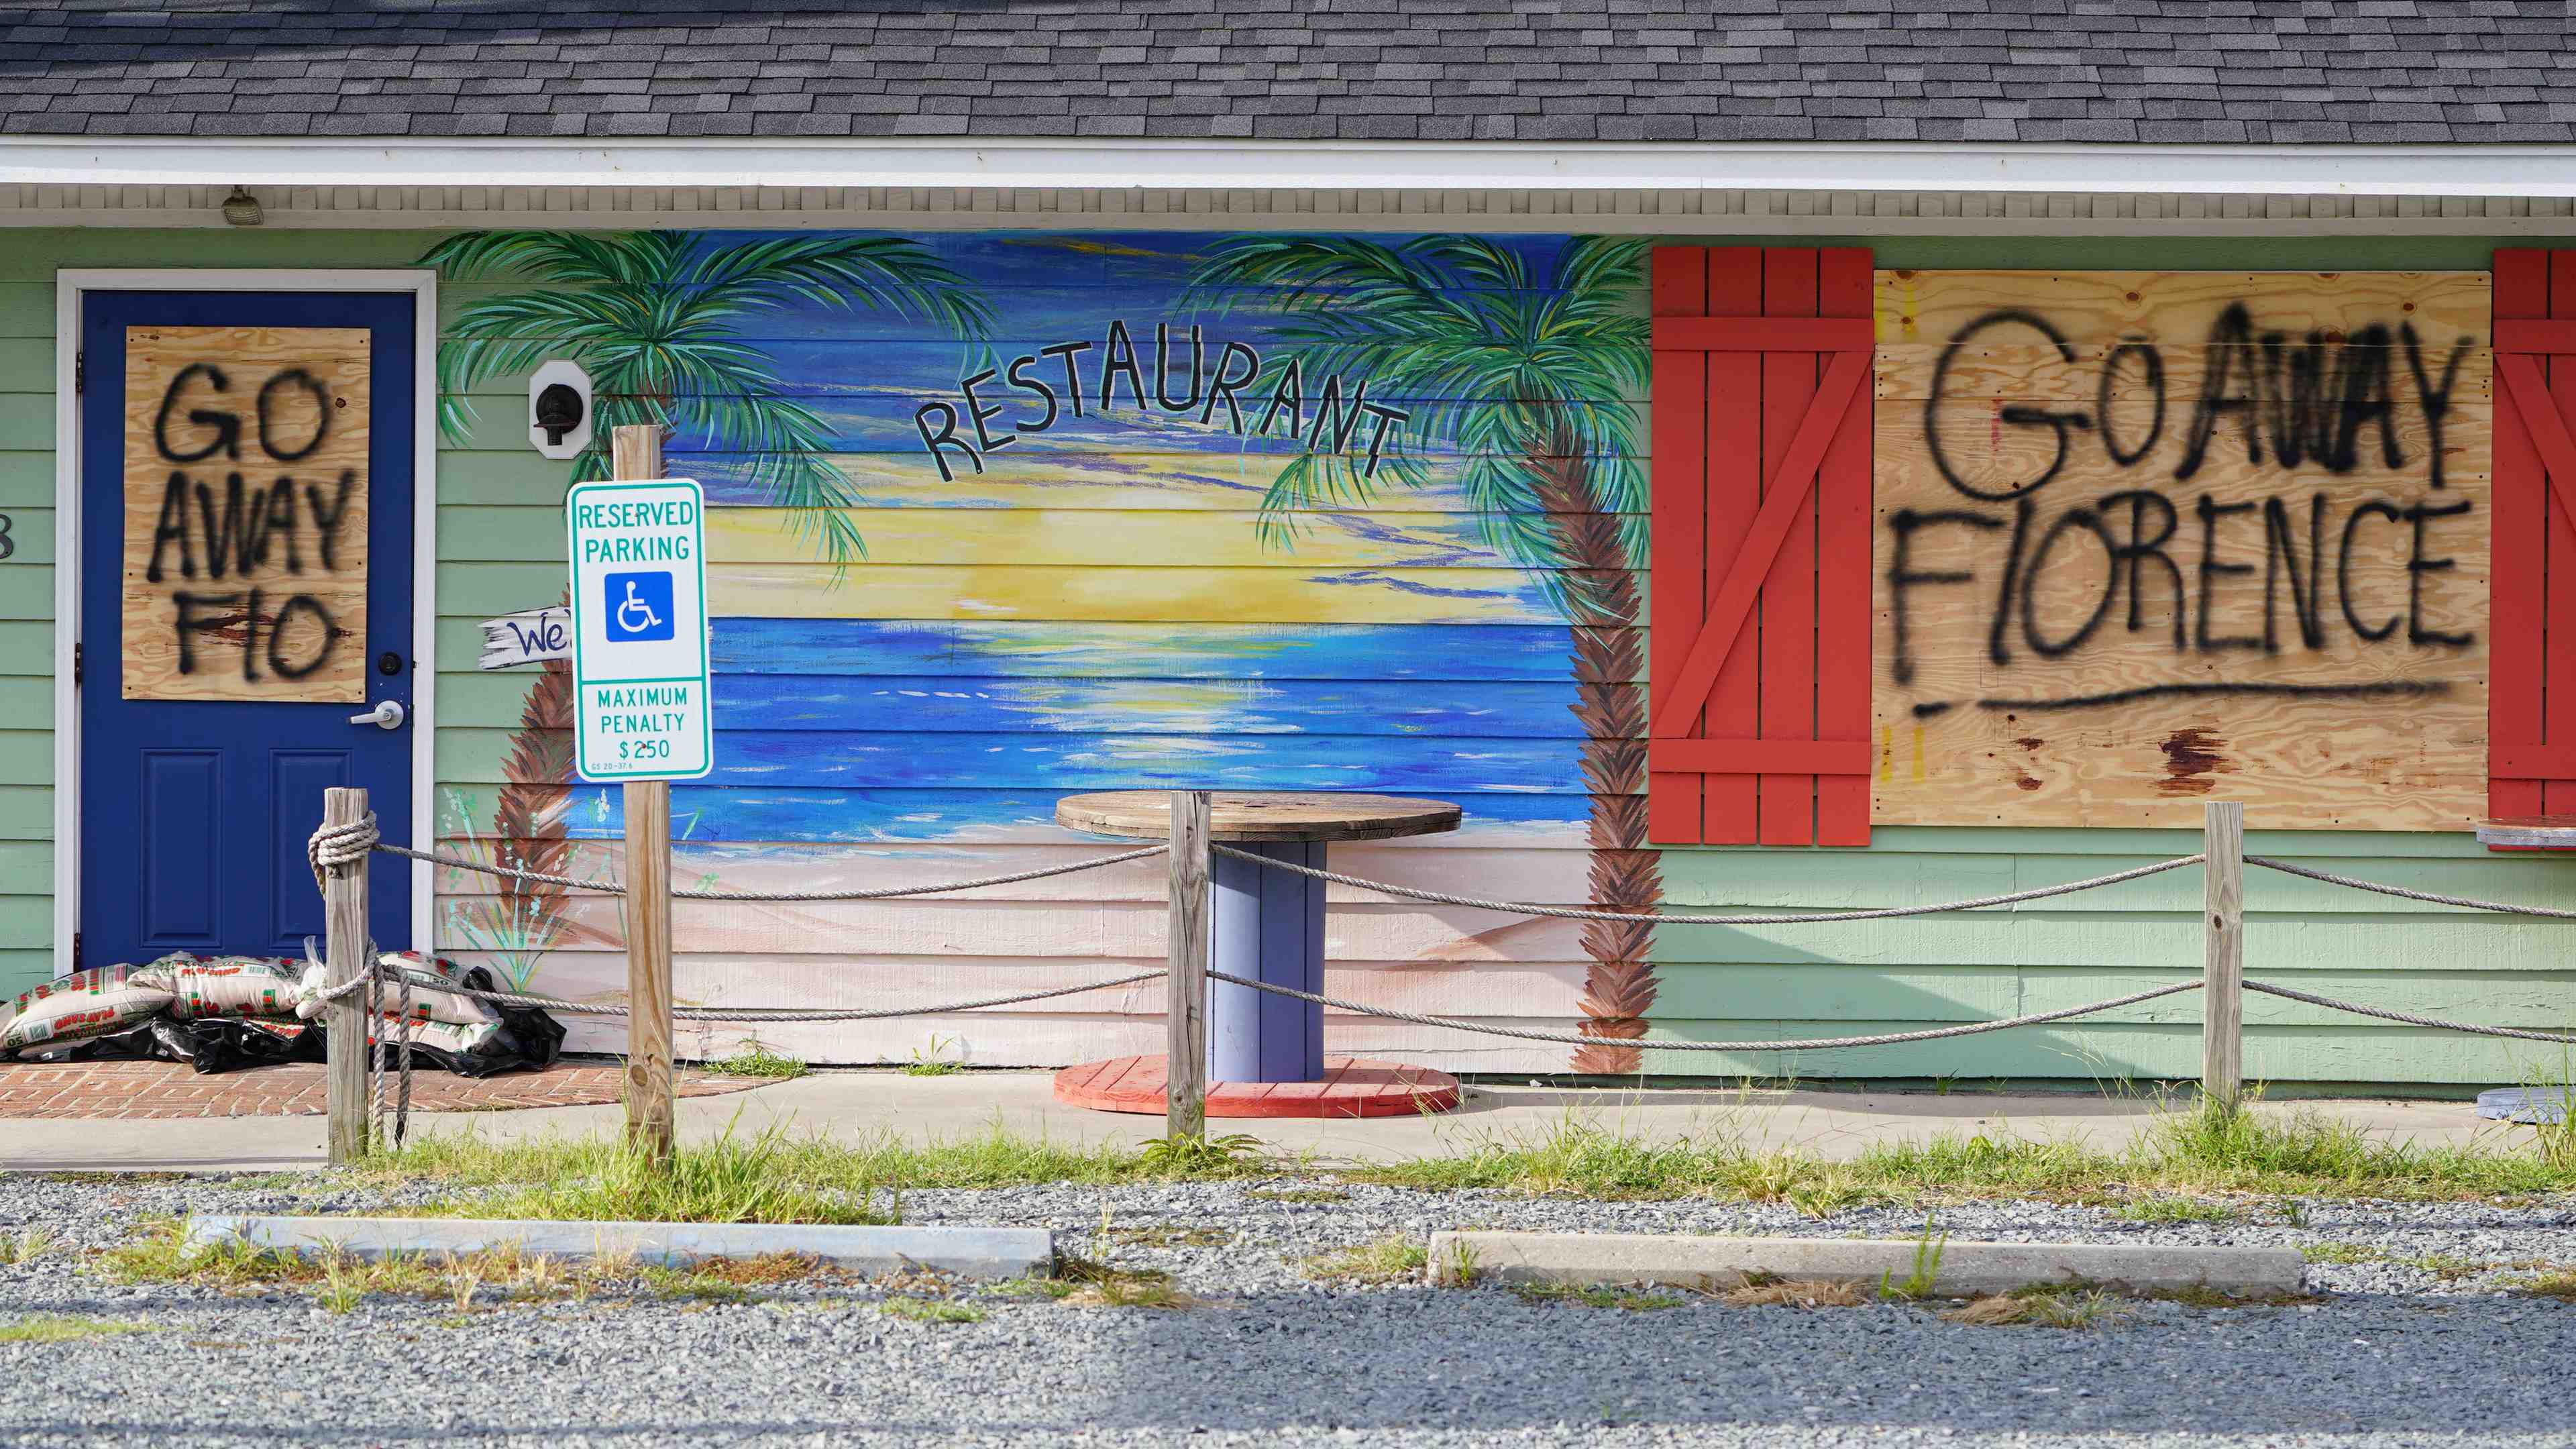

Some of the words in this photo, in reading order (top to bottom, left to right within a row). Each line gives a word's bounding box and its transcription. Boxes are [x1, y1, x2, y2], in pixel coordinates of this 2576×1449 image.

[154, 362, 331, 463] GO
[914, 320, 1409, 482] RESTAURANT
[1925, 307, 2167, 502] GO
[2175, 301, 2476, 488] AWAY
[146, 469, 356, 584] AWAY
[579, 501, 693, 528] RESERVED
[586, 536, 689, 562] PARKING
[506, 609, 572, 656] We
[598, 687, 687, 708] MAXIMUM
[601, 714, 684, 734] PENALTY
